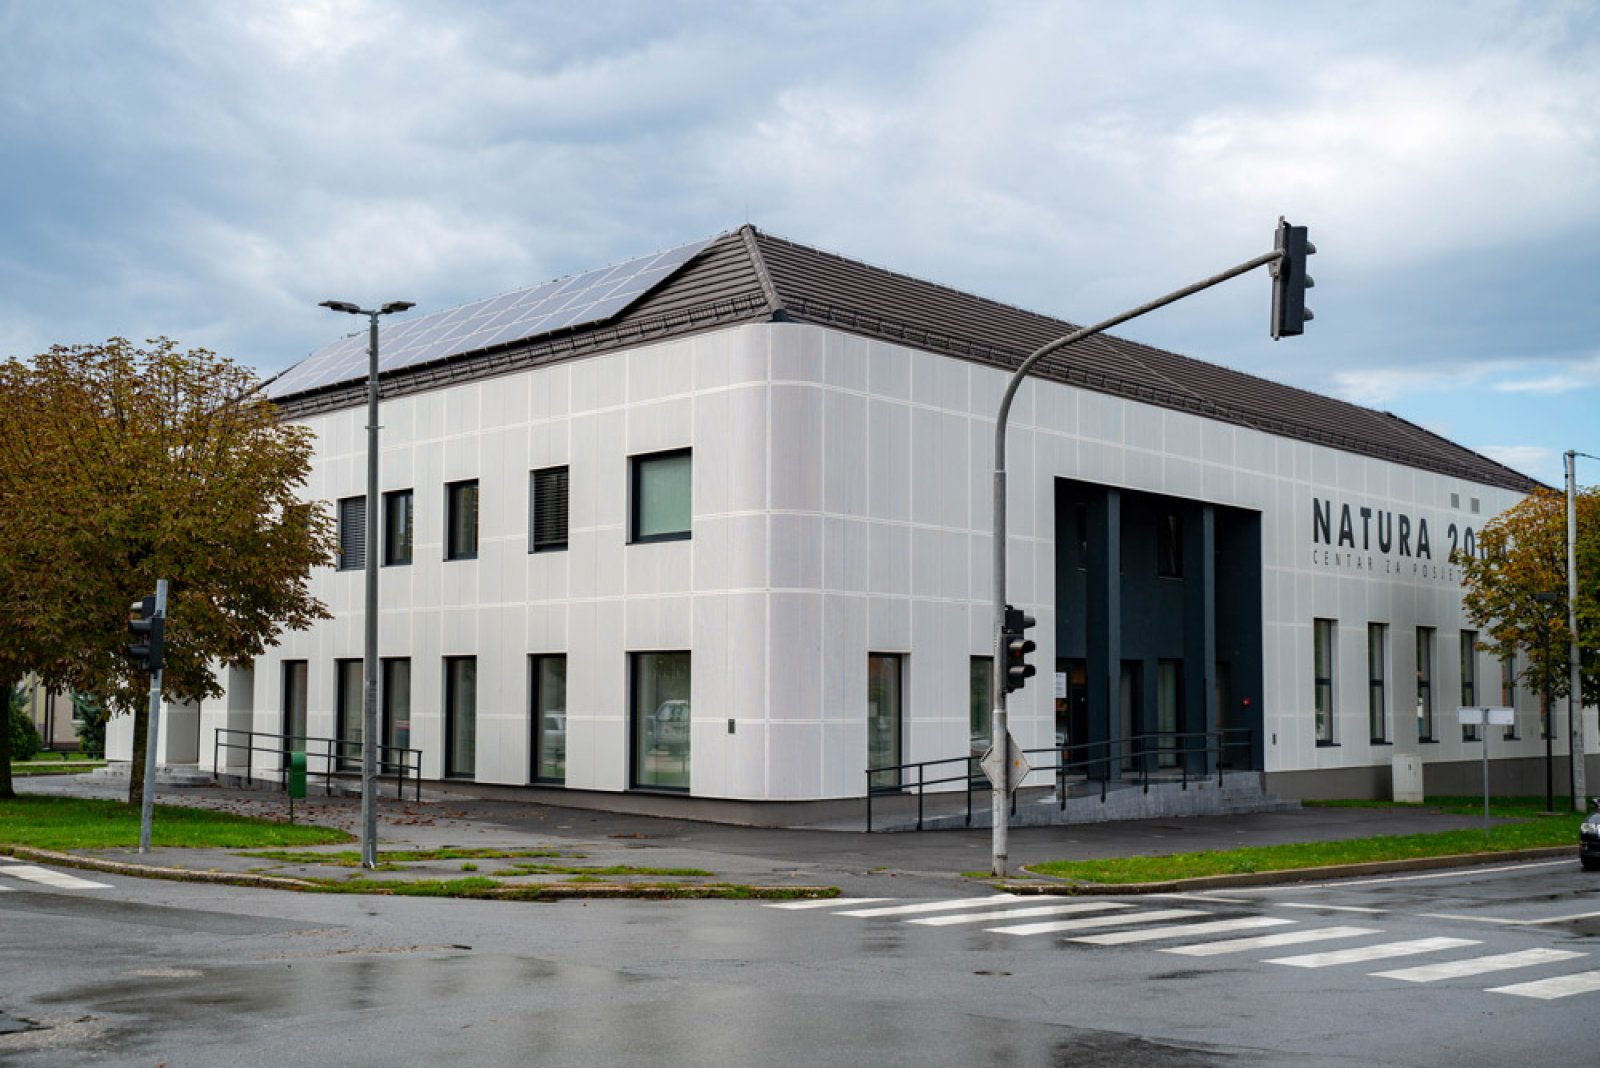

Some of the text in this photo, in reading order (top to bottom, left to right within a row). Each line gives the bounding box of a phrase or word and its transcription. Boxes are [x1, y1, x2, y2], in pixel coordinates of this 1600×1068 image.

[1313, 497, 1431, 560] NATURA
[1313, 549, 1373, 571] CENTAR
[1386, 559, 1401, 574] ZA
